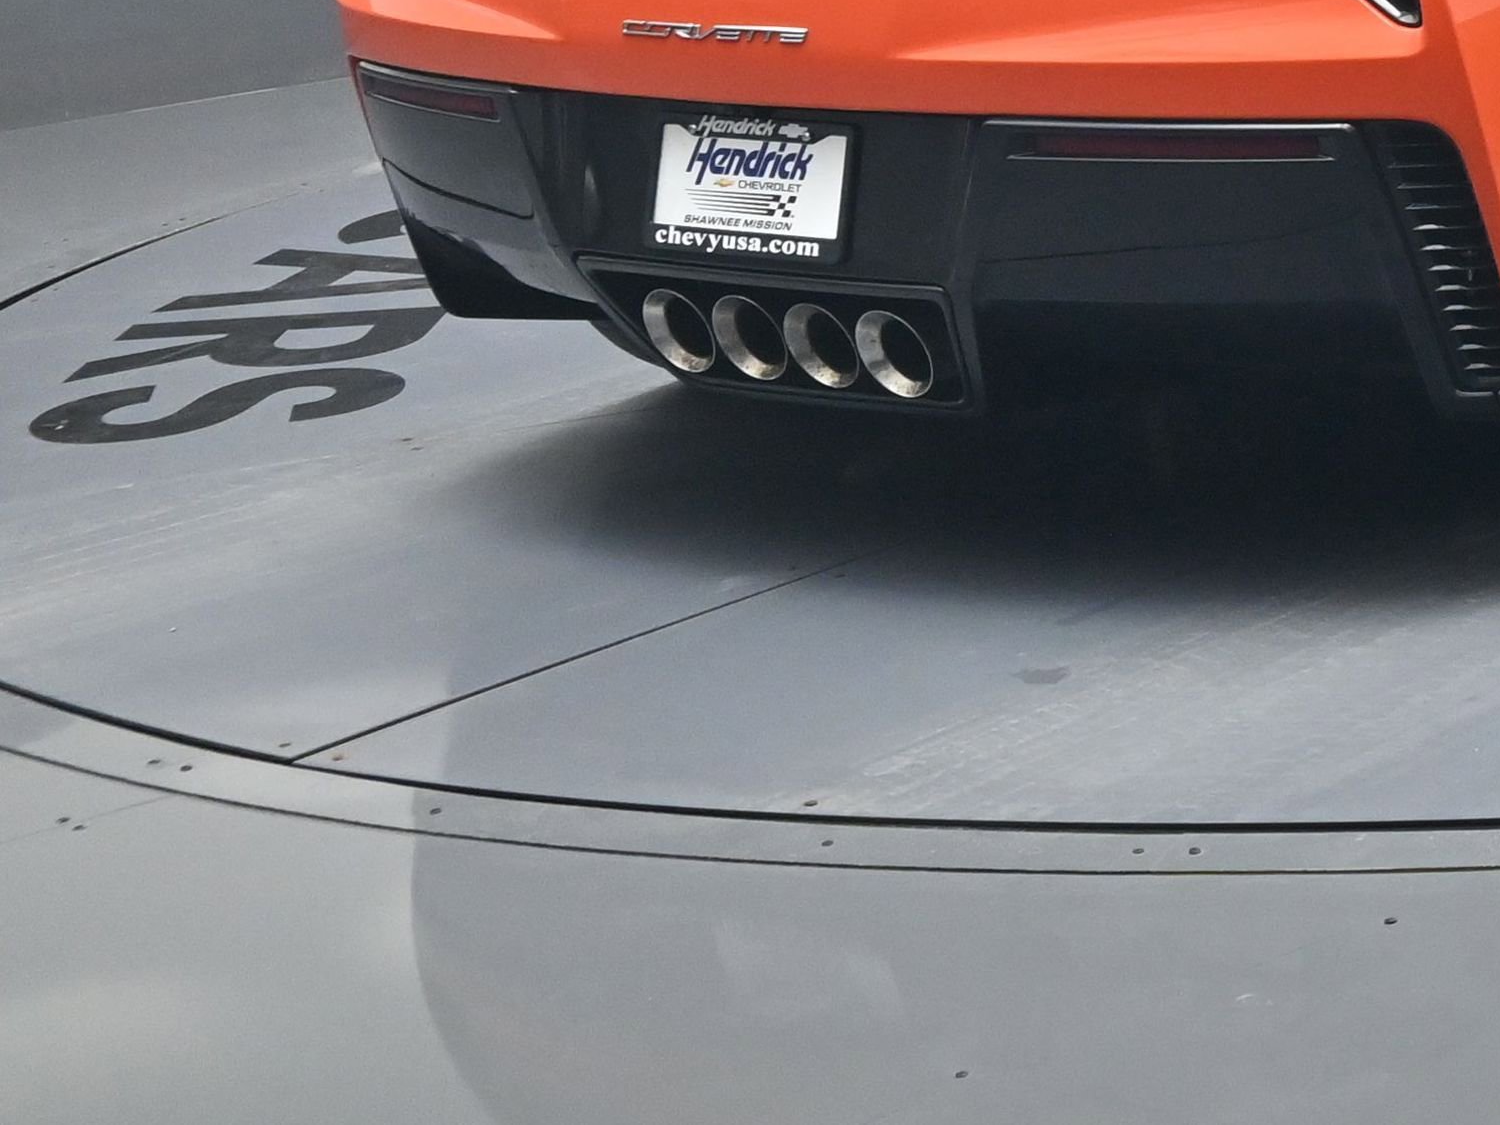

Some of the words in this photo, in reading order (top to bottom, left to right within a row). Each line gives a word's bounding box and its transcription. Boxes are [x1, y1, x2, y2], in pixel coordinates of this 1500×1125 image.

[622, 19, 809, 43] CORVETTE
[698, 114, 776, 137] Hendrick
[686, 135, 813, 185] Hendrick
[738, 179, 802, 193] CHEVROLET
[684, 214, 741, 227] SHAWNEE
[743, 219, 793, 231] MISSION
[655, 226, 819, 257] chevyusa.com
